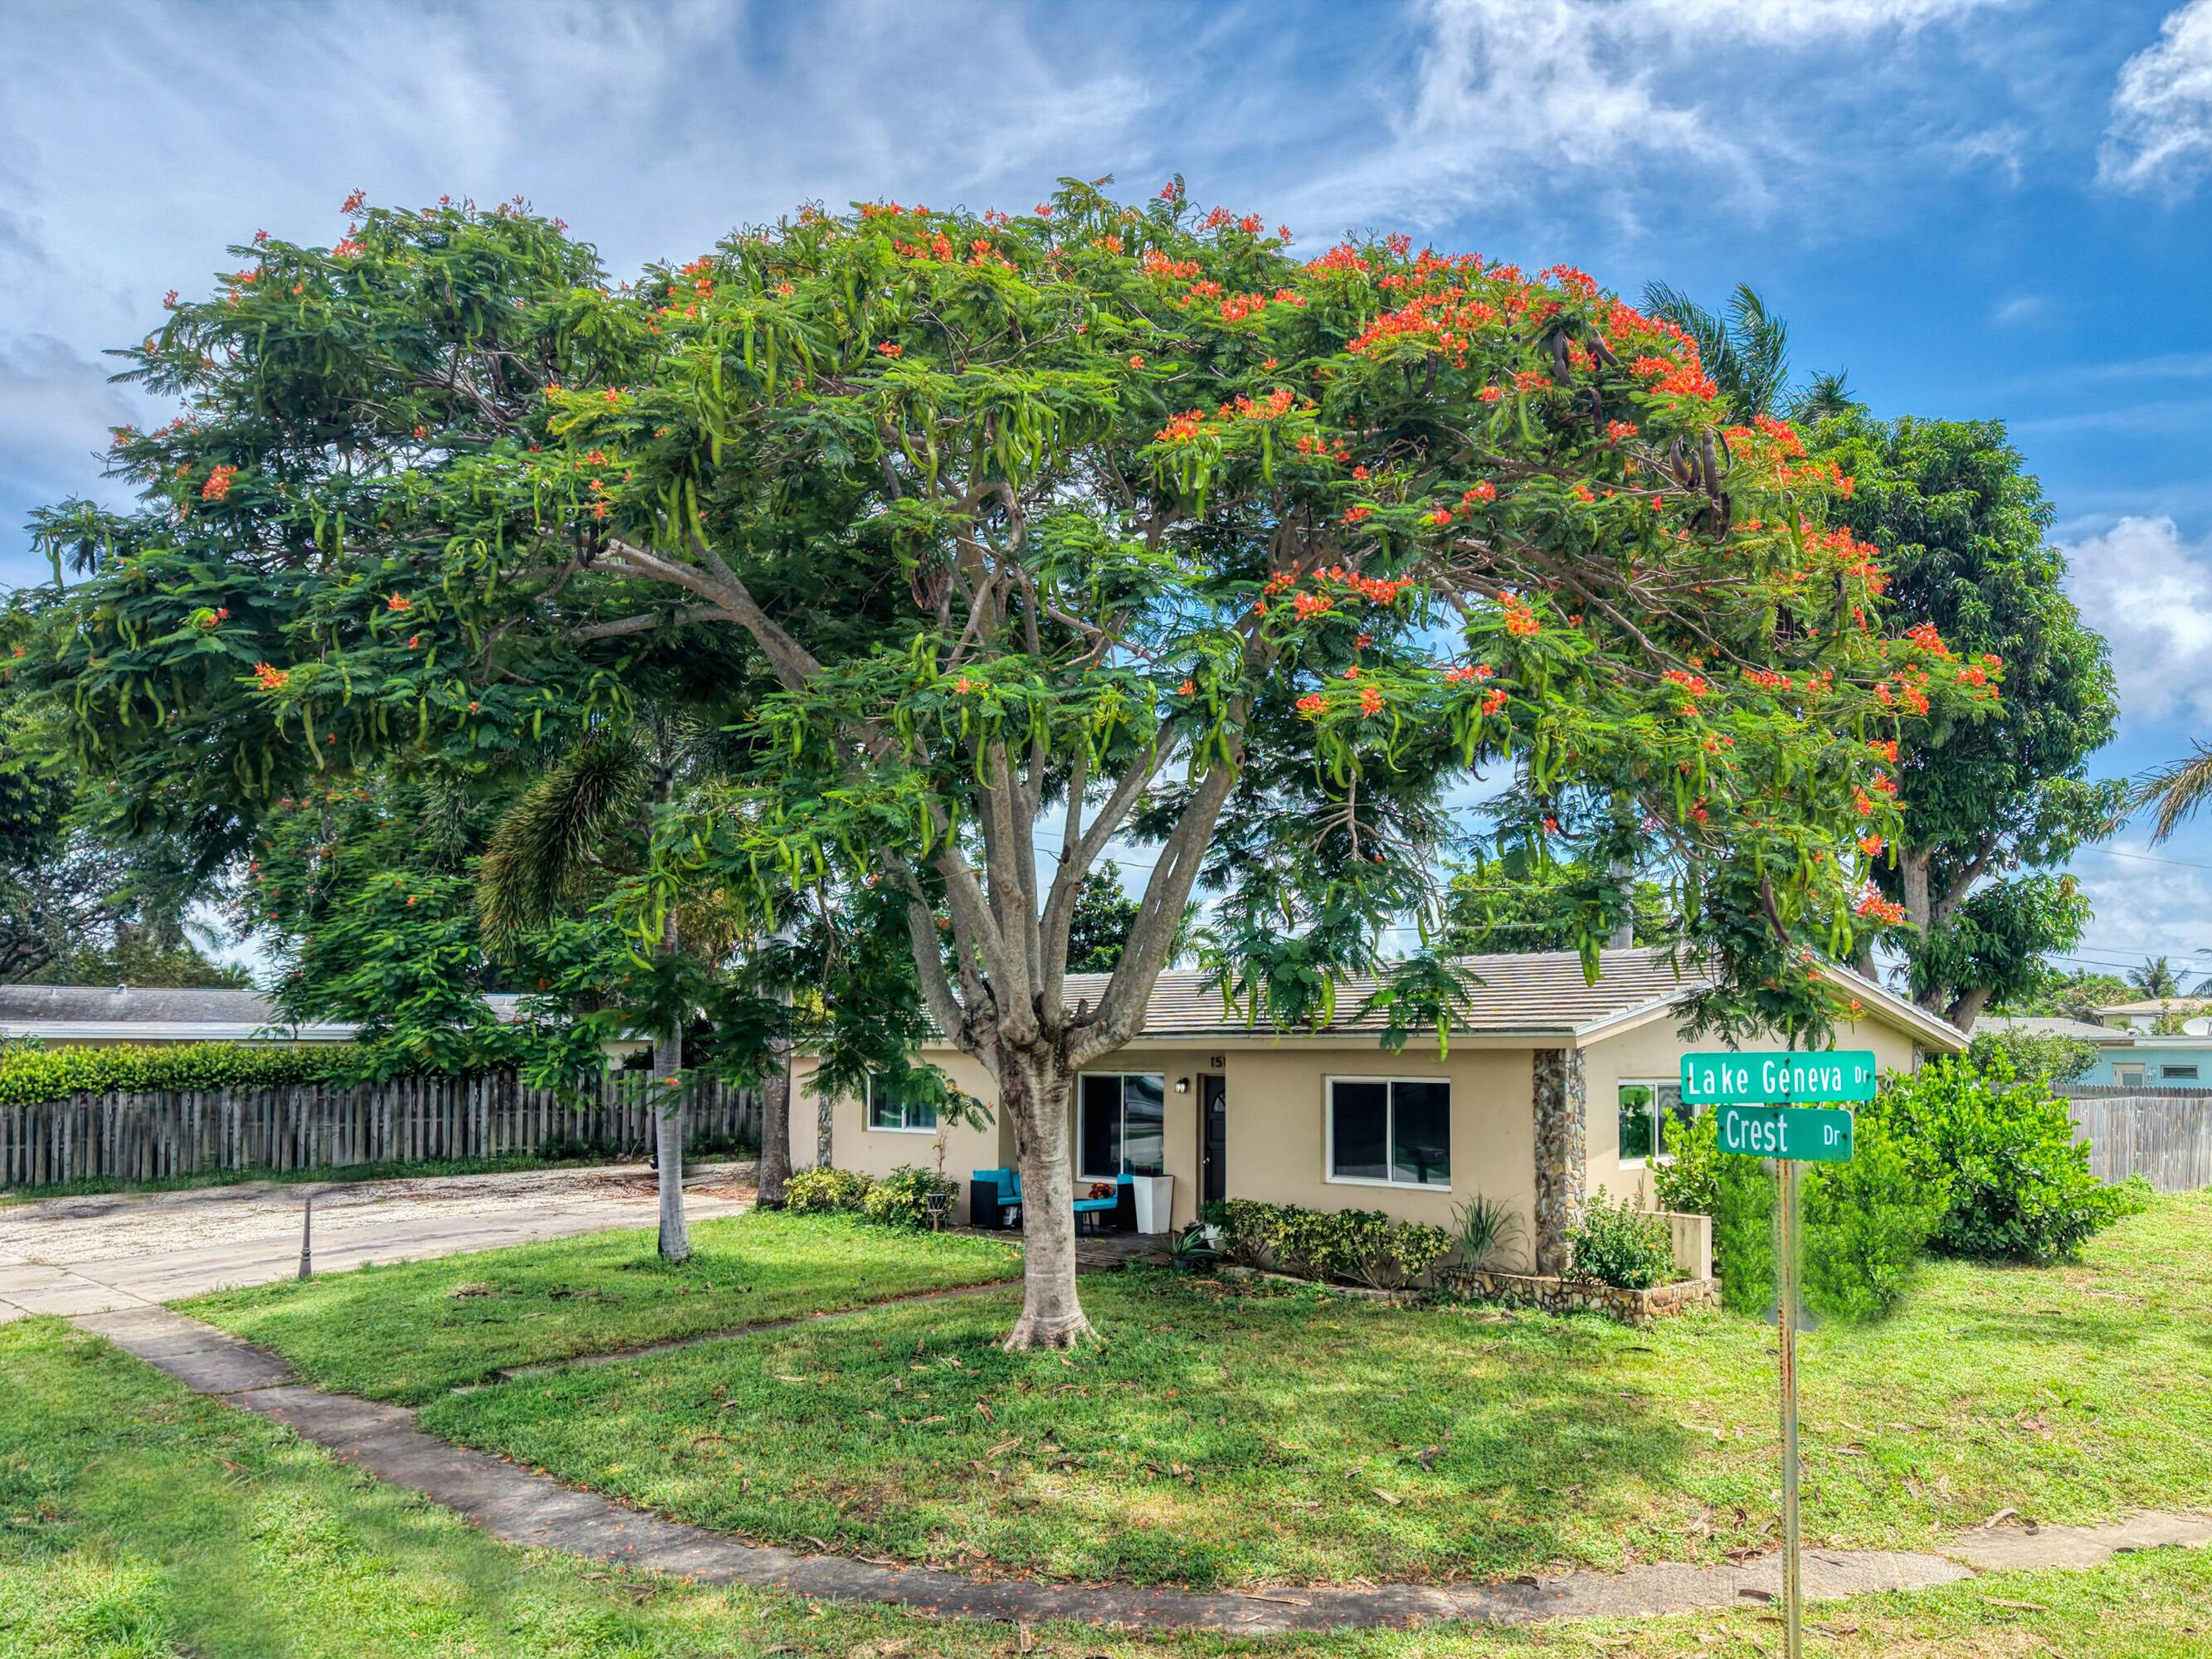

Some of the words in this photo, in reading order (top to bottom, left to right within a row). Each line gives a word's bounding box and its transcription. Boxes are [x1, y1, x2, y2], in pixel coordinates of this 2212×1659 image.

[1688, 1062, 1749, 1095] Lake
[1762, 1060, 1842, 1094] Geneva
[1854, 1066, 1869, 1084] Dr
[1727, 1110, 1788, 1152] Crest
[1824, 1125, 1840, 1146] Dr
